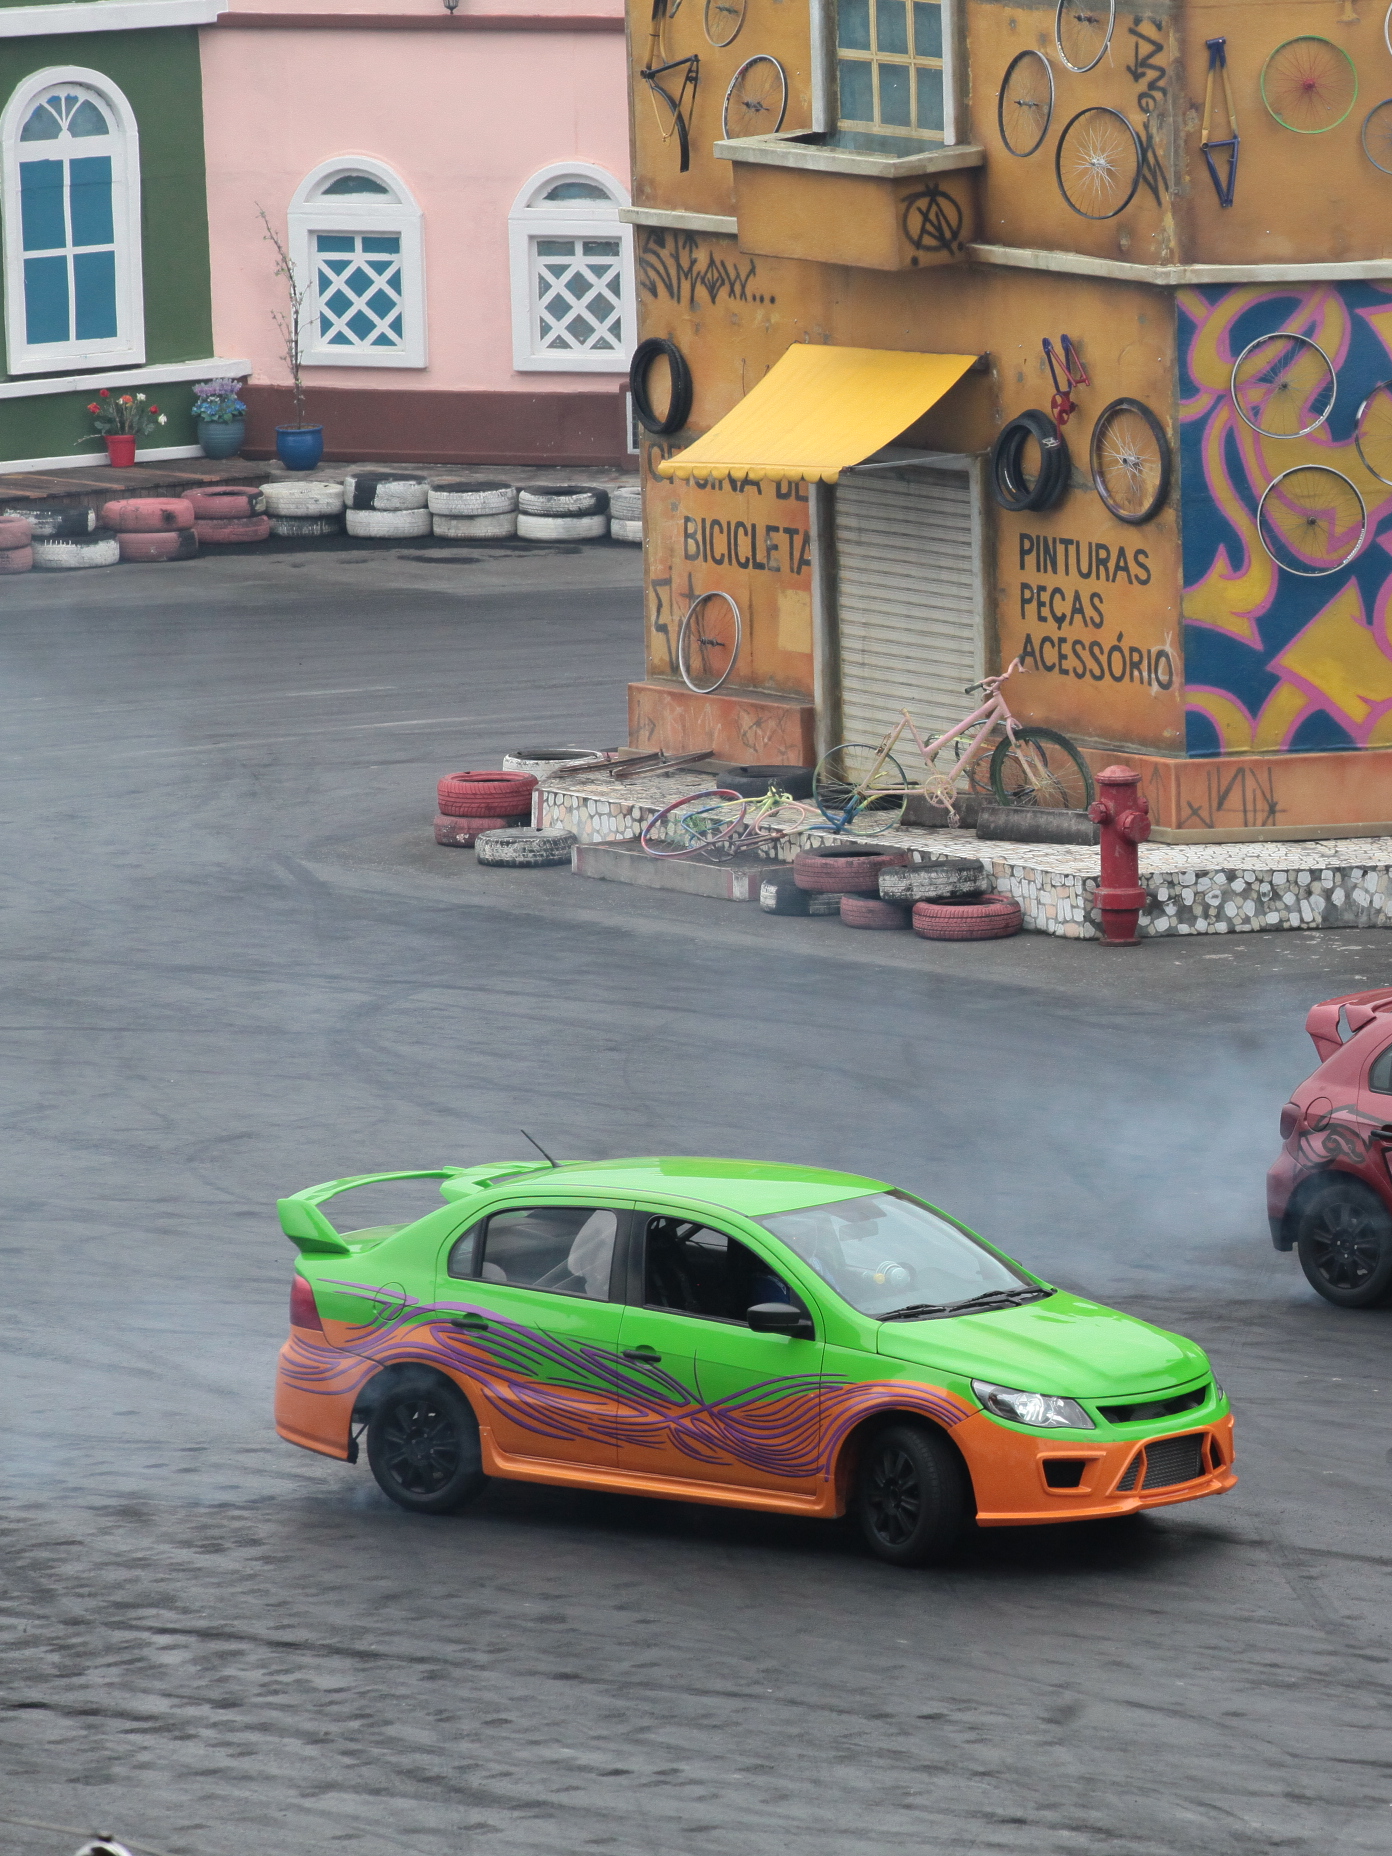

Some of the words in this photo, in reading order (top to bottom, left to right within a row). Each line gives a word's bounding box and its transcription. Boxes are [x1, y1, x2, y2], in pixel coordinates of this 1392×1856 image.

[1019, 532, 1152, 586] PINTURAS
[1020, 582, 1104, 631] PEÇAS
[1020, 630, 1174, 691] ACESSÓRIO
